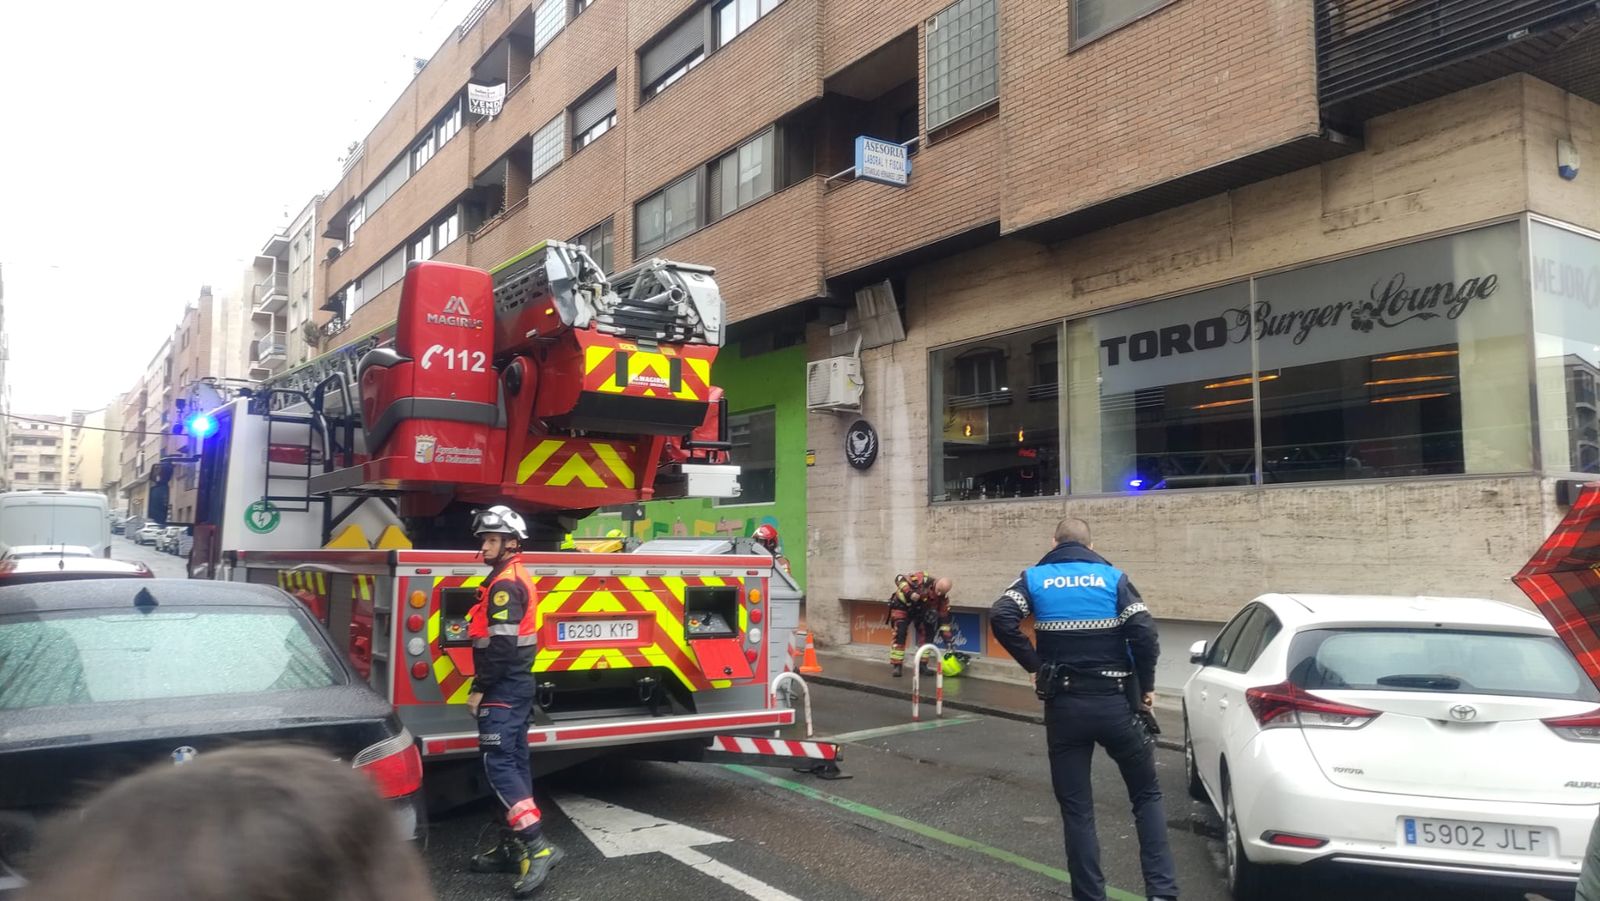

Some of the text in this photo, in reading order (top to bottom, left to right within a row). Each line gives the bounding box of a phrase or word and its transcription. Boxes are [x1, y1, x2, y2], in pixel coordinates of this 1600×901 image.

[864, 141, 904, 159] ASESORIA
[1101, 272, 1498, 366] TORO Burger Lounge
[443, 348, 486, 373] 112
[1043, 573, 1106, 589] POLICÍA
[568, 624, 601, 639] 6290
[610, 623, 633, 637] KYP
[1332, 766, 1364, 775] TOYOTA
[1422, 823, 1541, 851] 5902 JLF
